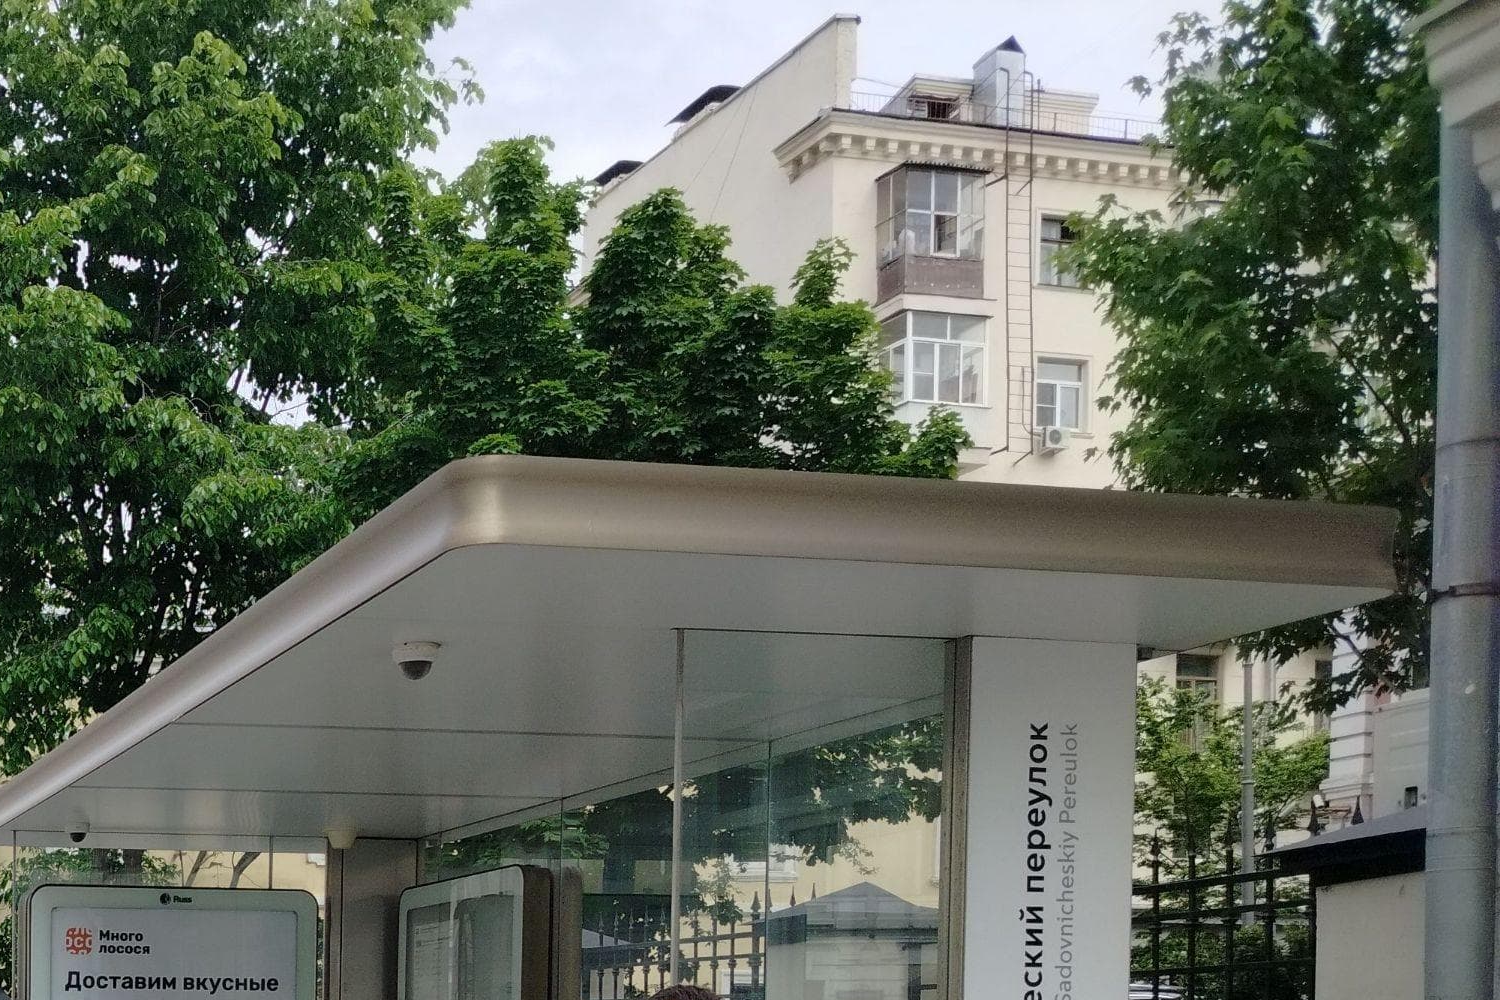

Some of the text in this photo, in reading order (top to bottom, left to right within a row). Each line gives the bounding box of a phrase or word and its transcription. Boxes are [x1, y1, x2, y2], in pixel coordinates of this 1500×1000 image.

[1058, 723, 1078, 824] Pereulok
[1027, 722, 1053, 893] переулок
[172, 895, 193, 904] Russ
[99, 929, 144, 942] Много
[98, 944, 151, 955] лосося
[64, 970, 279, 995] Доставим вкусные
